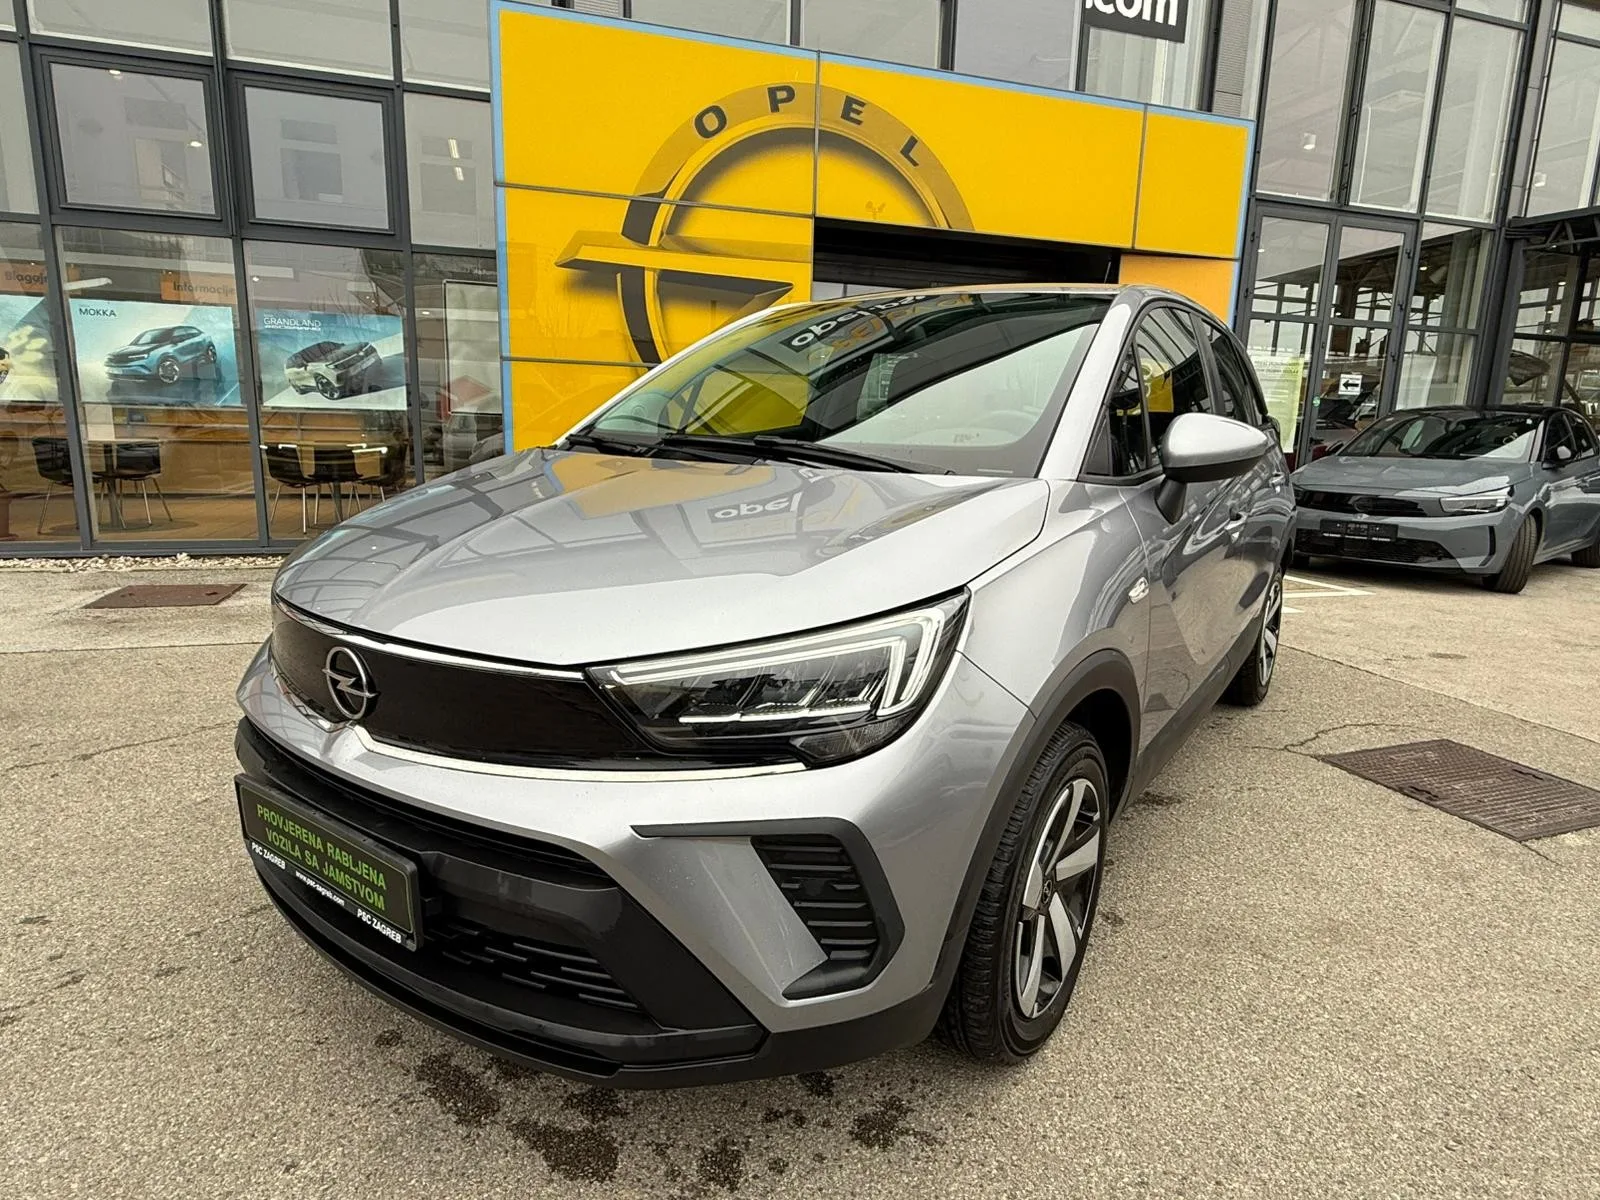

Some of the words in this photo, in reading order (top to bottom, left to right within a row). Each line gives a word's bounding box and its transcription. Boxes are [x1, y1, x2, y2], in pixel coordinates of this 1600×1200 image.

[694, 85, 919, 167] OPEL
[79, 307, 117, 318] MOKKA
[263, 316, 322, 328] GRANDLAND
[256, 804, 324, 853] PROVJERENA
[327, 842, 387, 890] RABLJENA
[263, 848, 286, 870] ZAGREB
[266, 827, 301, 858] VOZILA
[305, 850, 320, 871] SA
[323, 861, 385, 910] JAMSTVOM
[357, 908, 372, 924] PSC
[372, 916, 402, 944] ZAGREB
